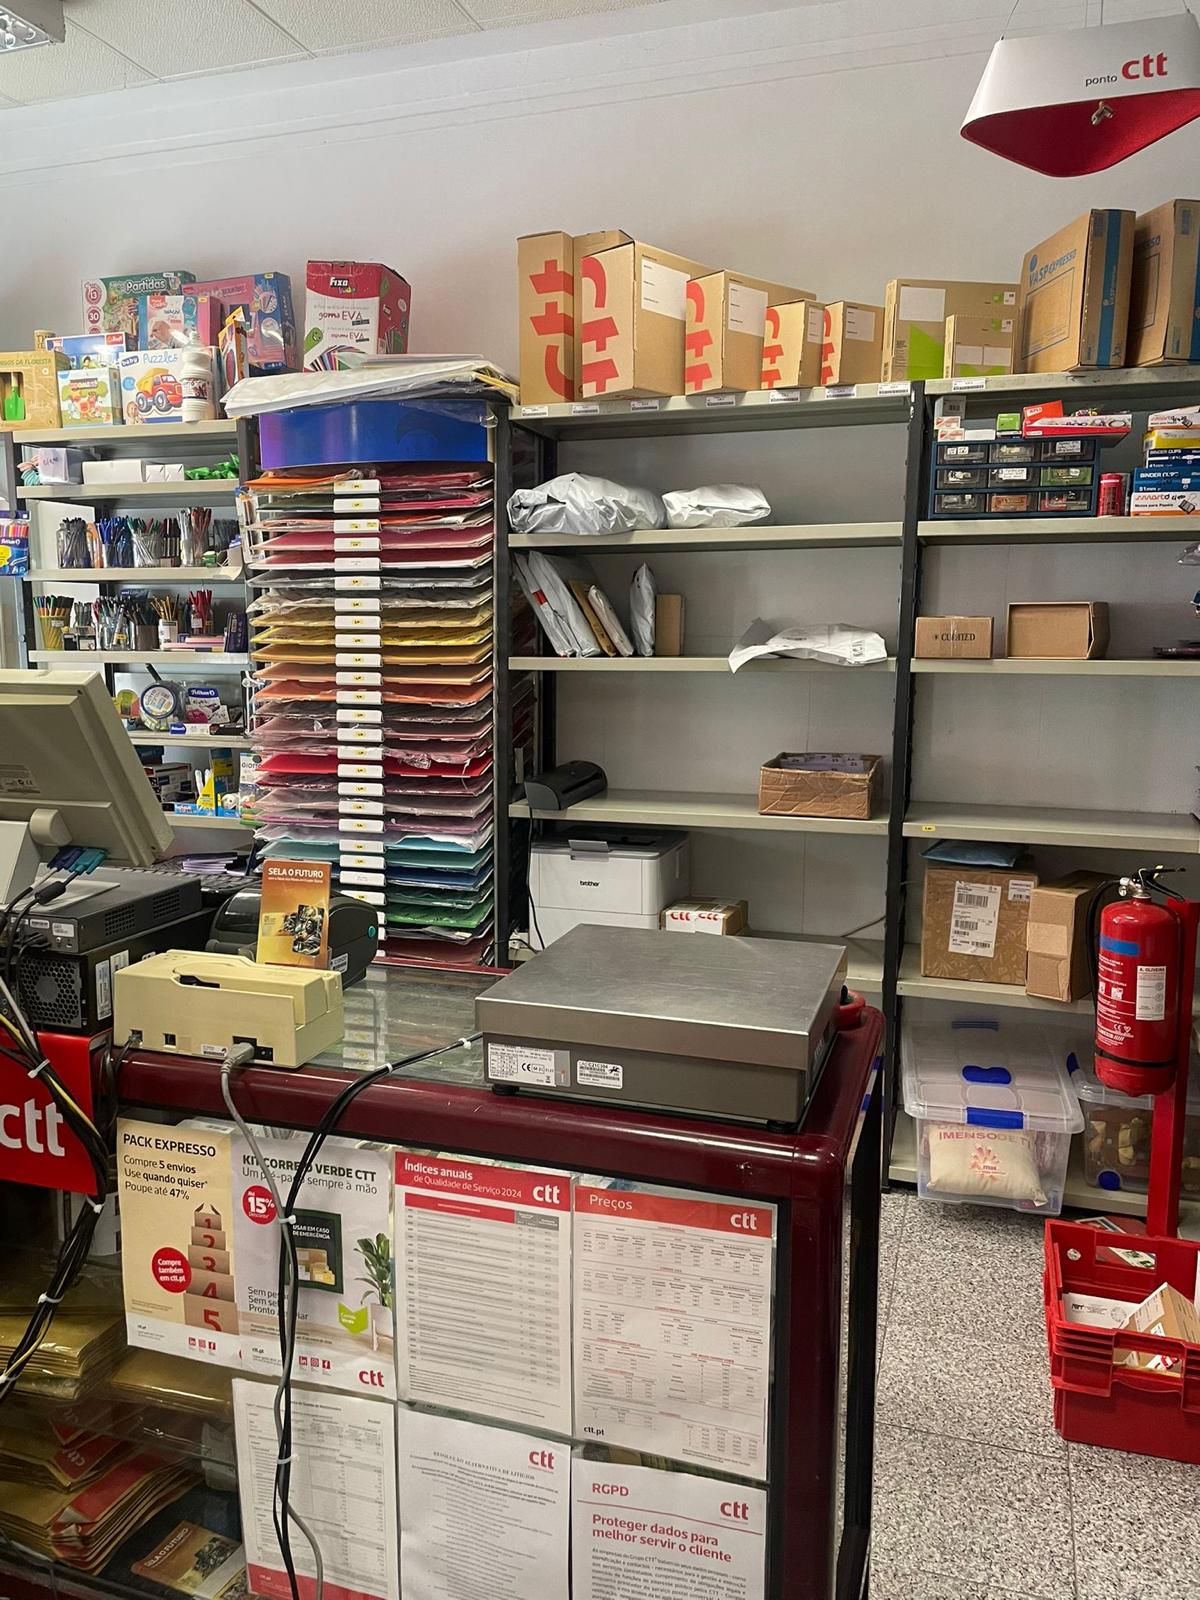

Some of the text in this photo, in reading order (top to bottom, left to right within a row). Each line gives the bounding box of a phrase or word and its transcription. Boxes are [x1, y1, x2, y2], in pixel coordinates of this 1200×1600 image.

[1085, 52, 1168, 87] ponto ctt
[126, 279, 166, 292] Partidas
[89, 313, 99, 321] 30
[142, 353, 178, 364] Puzzles
[268, 867, 324, 878] SELA O FUTURO
[0, 1098, 65, 1157] ctt
[939, 1131, 998, 1141] IMENSO
[123, 1133, 217, 1157] PACK EXPRESSO
[123, 1154, 197, 1174] Compre 5 envios
[315, 1163, 353, 1178] VERDE
[355, 1169, 377, 1182] CTT
[404, 1158, 473, 1181] Índices anuais
[124, 1168, 142, 1179] Use
[143, 1172, 176, 1185] quando
[242, 1166, 259, 1179] Um
[307, 1175, 344, 1189] sempre
[355, 1183, 378, 1195] mão
[125, 1181, 190, 1200] Poupe até 47%
[413, 1174, 522, 1198] de Qualidade de Serviço 2024
[532, 1184, 560, 1204] ctt
[247, 1196, 275, 1214] 15%
[589, 1194, 633, 1211] Preços
[204, 1218, 211, 1229] 1
[316, 1226, 330, 1234] CASO
[730, 1212, 758, 1231] ctt
[300, 1230, 331, 1240] EMERGÊNCIA
[158, 1258, 182, 1267] Compre
[159, 1266, 184, 1274] também
[203, 1256, 217, 1272] 3
[202, 1282, 219, 1298] 4
[247, 1286, 267, 1297] Sem
[248, 1295, 267, 1306] Sem
[249, 1303, 276, 1316] Pronto
[203, 1309, 222, 1332] 5
[358, 1370, 385, 1388] ctt
[583, 1426, 605, 1436] ctt.pt
[529, 1450, 555, 1470] ctt
[592, 1483, 629, 1497] RGPD
[720, 1500, 749, 1520] ctt
[592, 1514, 719, 1546] Proteger dados para
[592, 1527, 732, 1562] melhor servir o cliente
